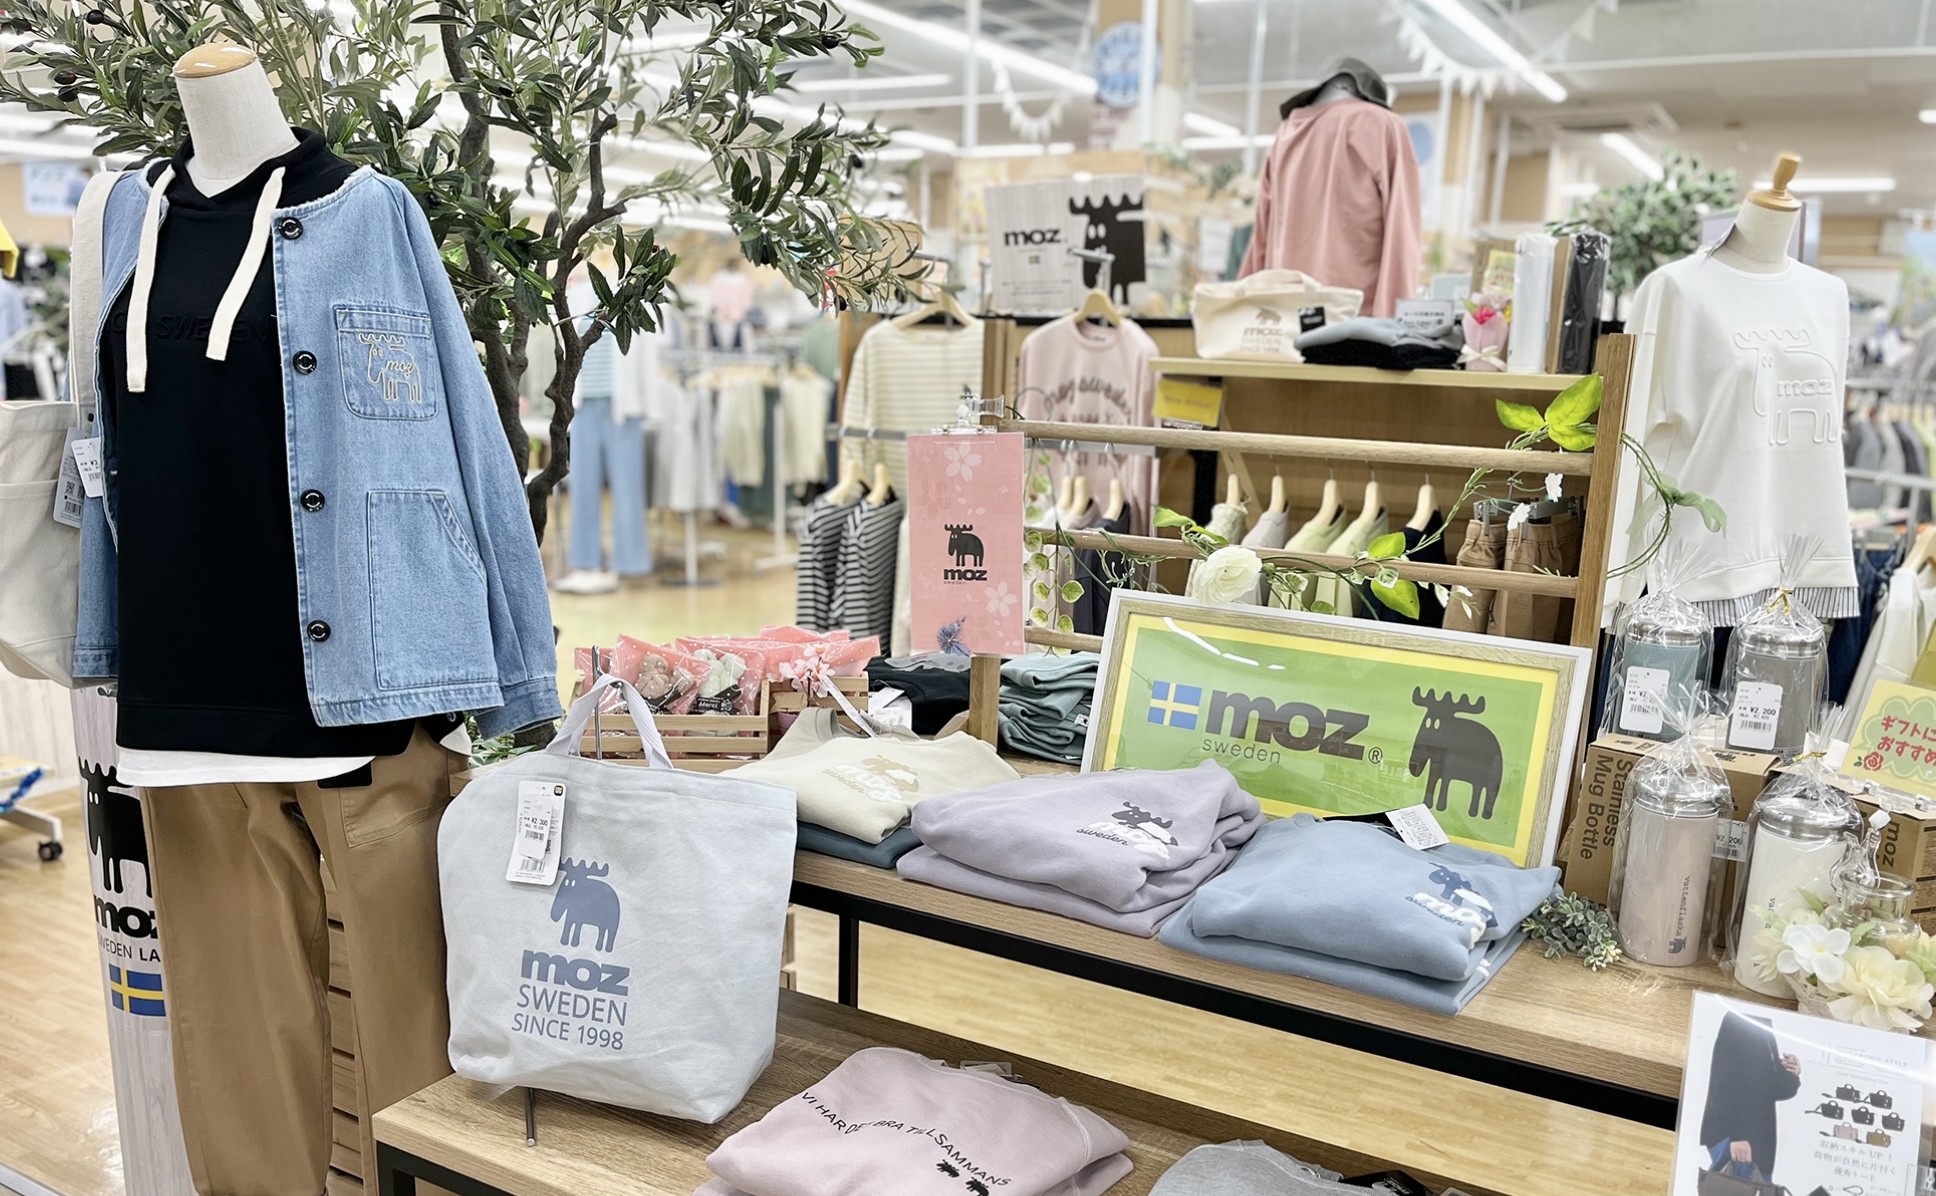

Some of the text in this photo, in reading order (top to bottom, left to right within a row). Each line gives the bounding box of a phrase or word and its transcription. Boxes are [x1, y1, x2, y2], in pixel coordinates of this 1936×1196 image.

[1004, 228, 1061, 246] moz
[155, 314, 269, 345] SWEEN
[386, 360, 414, 379] moz
[1777, 379, 1833, 397] moz
[943, 568, 988, 581] moz
[1205, 690, 1370, 760] moz
[1881, 715, 1936, 742] ギフトに
[1202, 737, 1281, 764] sweden
[1580, 754, 1614, 860] Mug Bottle
[1602, 758, 1635, 848] Stainless
[1076, 828, 1128, 846] sweden
[1881, 822, 1901, 868] moz
[100, 935, 161, 962] WEDEN LA
[521, 949, 630, 996] moz
[517, 984, 627, 1026] SWEDEN
[511, 1013, 623, 1050] SINCE 1998
[802, 1092, 817, 1104] VI
[815, 1105, 846, 1131] HAR
[873, 1120, 904, 1130] BRA
